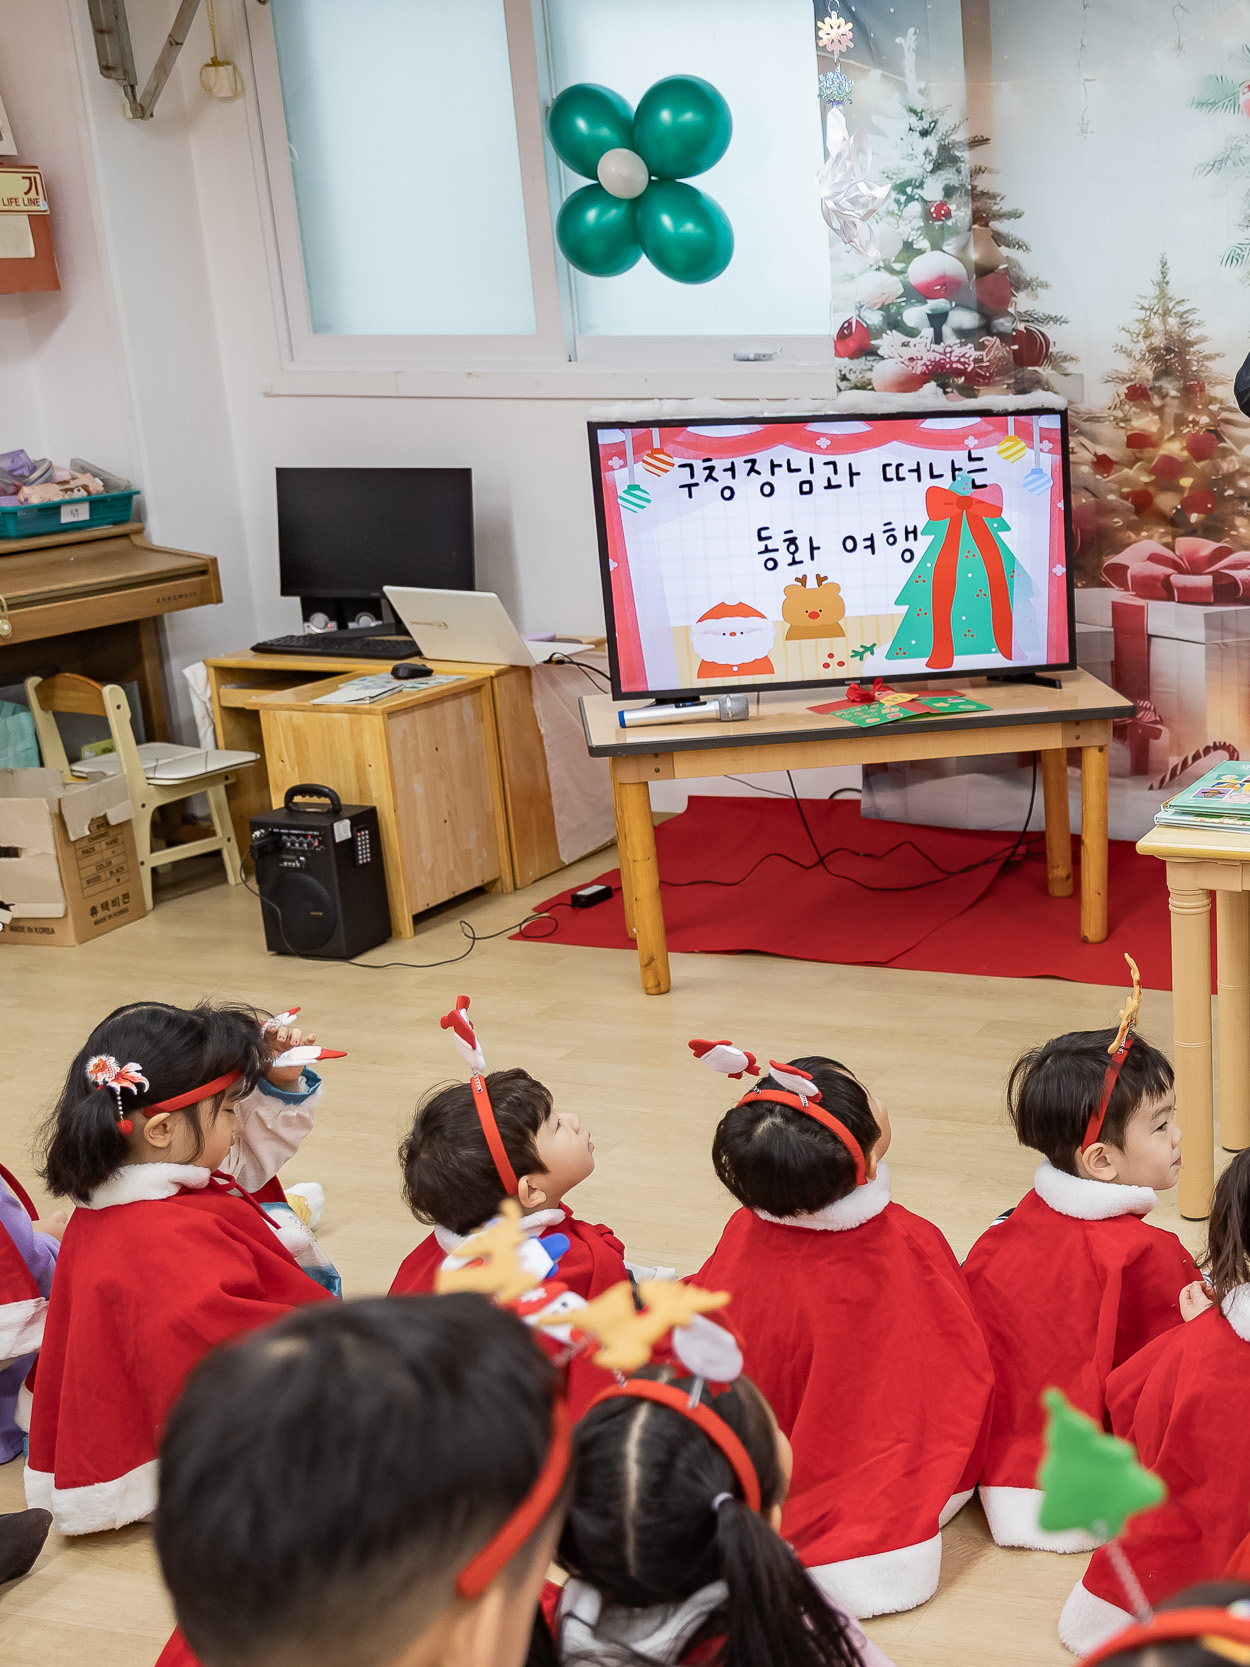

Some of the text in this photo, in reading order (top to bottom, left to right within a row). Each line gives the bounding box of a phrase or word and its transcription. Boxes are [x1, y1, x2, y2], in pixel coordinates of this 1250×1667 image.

[2, 197, 41, 207] LIFE LINE
[677, 449, 988, 501] 구청장님과 떠나는
[757, 521, 918, 571] 동화 여행
